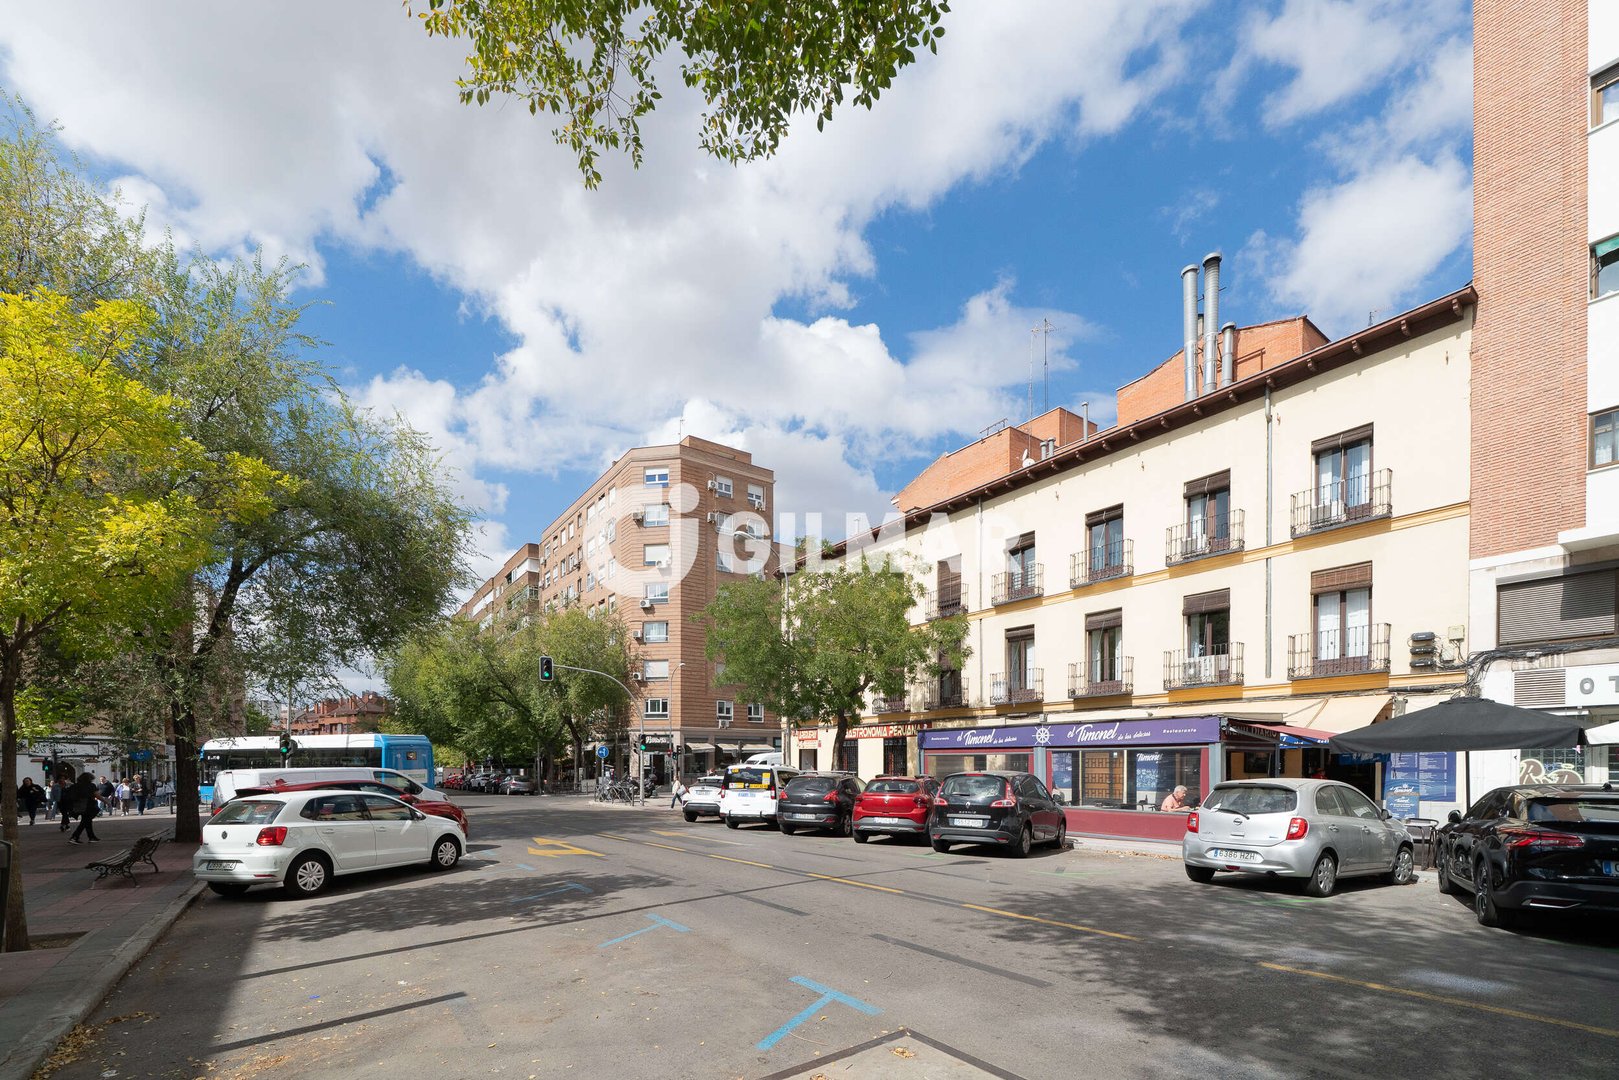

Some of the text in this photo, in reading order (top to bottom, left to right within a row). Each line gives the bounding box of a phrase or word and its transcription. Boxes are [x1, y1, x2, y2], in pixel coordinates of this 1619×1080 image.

[963, 728, 996, 746] Timonel
[1066, 726, 1076, 738] el
[1076, 722, 1120, 742] Timonel
[1239, 852, 1255, 860] HZH
